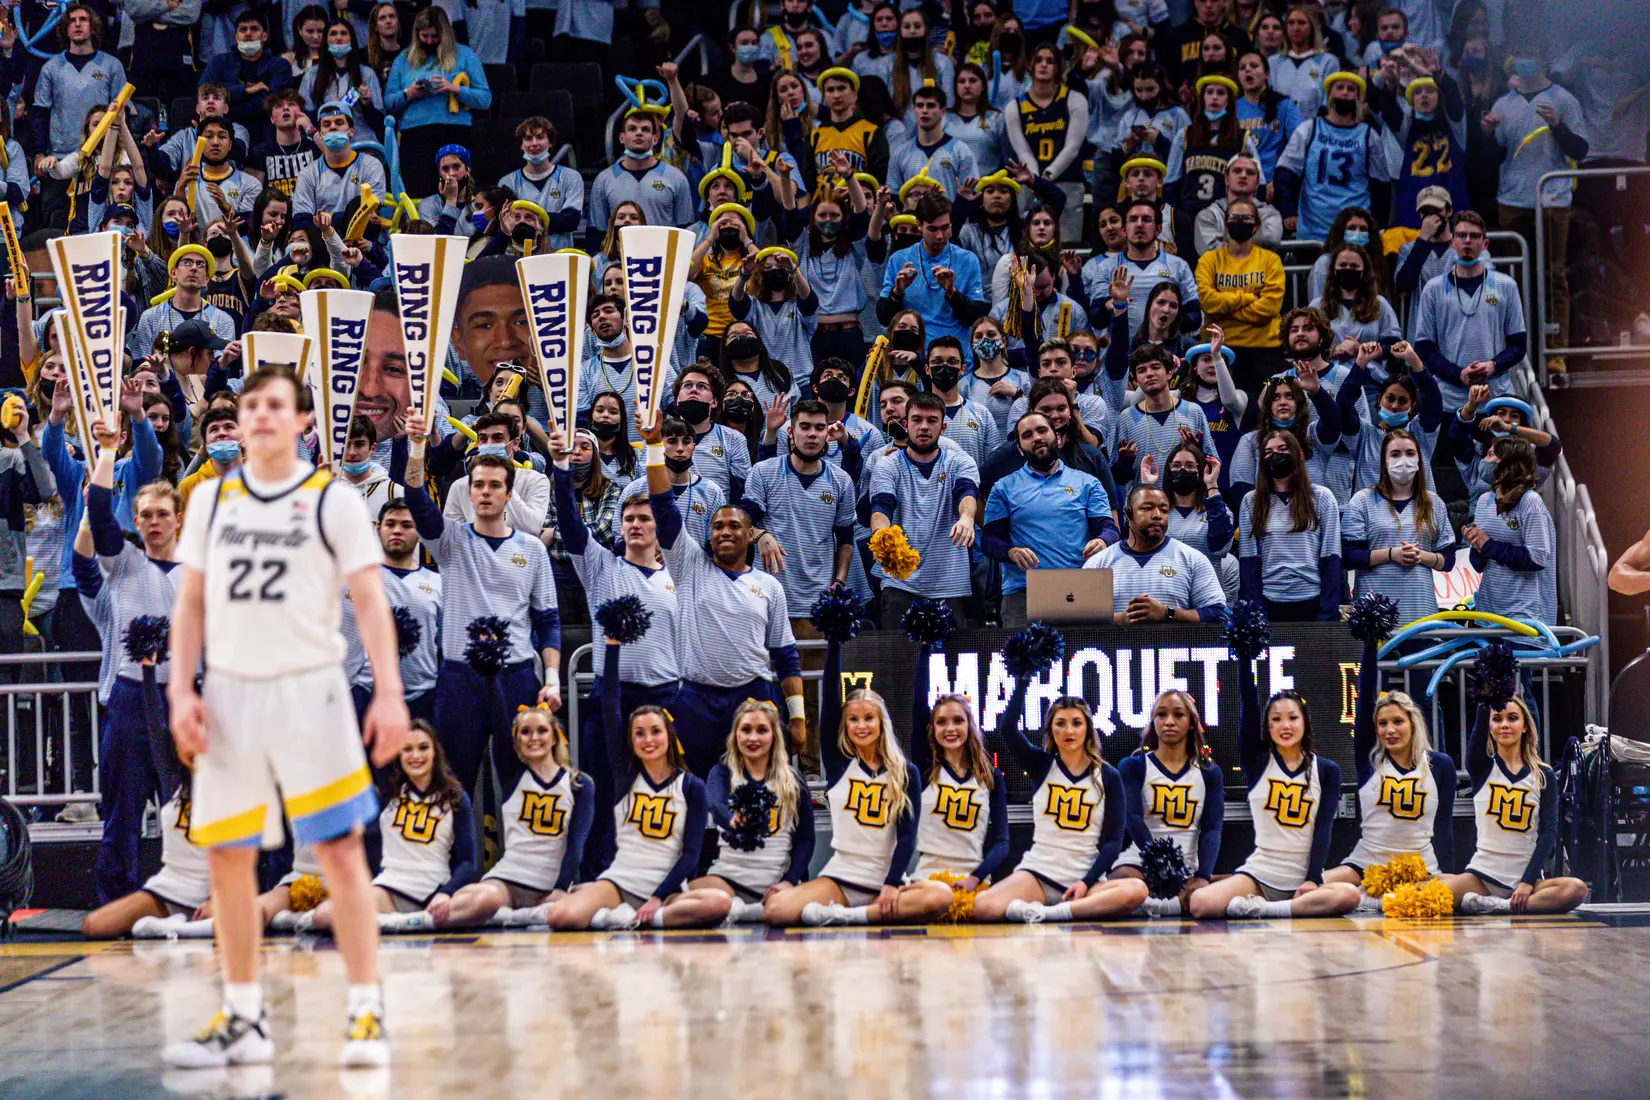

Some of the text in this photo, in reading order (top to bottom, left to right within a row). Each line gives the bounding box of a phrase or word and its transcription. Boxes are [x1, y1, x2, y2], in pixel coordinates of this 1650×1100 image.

[1038, 138, 1055, 161] 0
[1316, 147, 1353, 187] 13
[1411, 137, 1453, 177] 22
[1197, 174, 1215, 200] 3
[72, 259, 112, 340] RING
[397, 263, 430, 341] RING
[331, 317, 366, 395] RING
[528, 280, 567, 431] RING OUT
[626, 256, 662, 409] RING OUT
[91, 348, 113, 412] OUT
[229, 559, 288, 601] 22
[517, 789, 567, 838] MU
[627, 791, 678, 841] MU
[843, 778, 892, 829] MU
[930, 782, 983, 833] MU
[1044, 782, 1095, 832] MU
[1148, 782, 1199, 831] MU
[1264, 777, 1316, 829] MU
[1376, 775, 1428, 822] MU
[1485, 781, 1537, 833] MU
